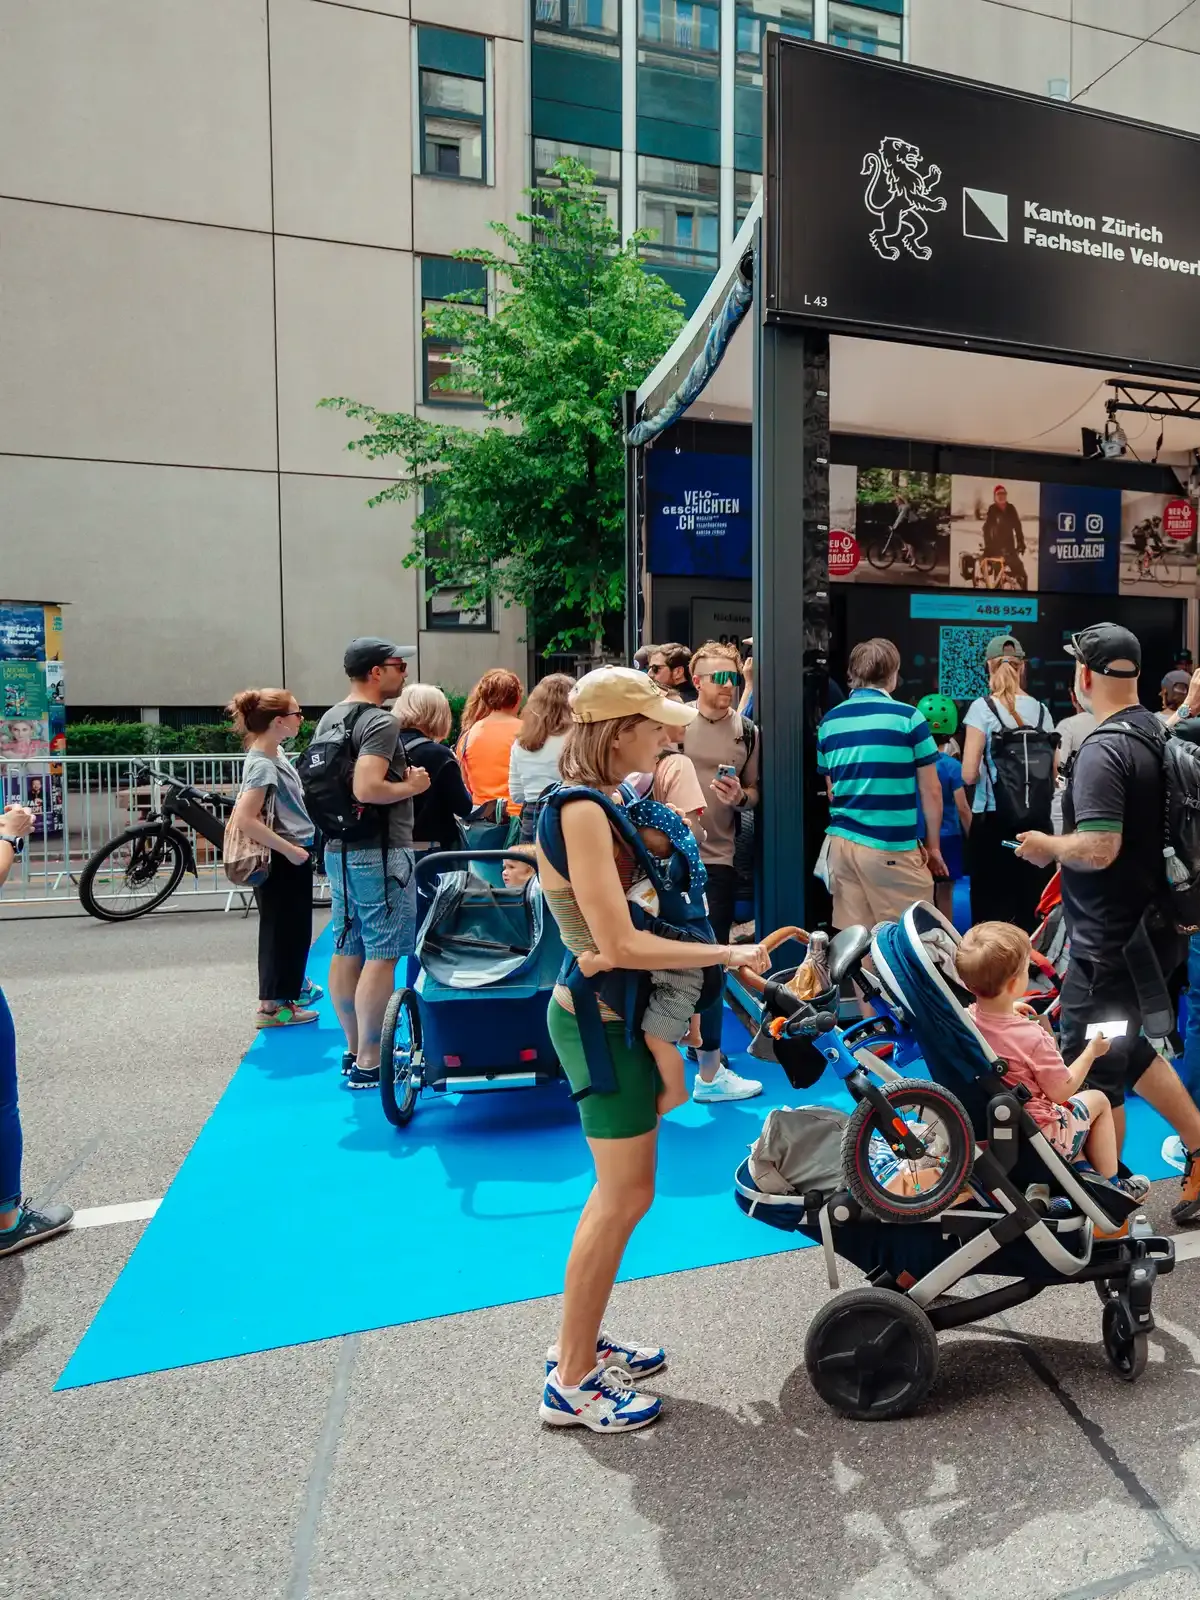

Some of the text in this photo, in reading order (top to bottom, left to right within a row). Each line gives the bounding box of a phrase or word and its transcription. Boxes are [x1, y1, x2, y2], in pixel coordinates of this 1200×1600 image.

[1024, 200, 1164, 244] Kanton Zürich
[1023, 226, 1125, 262] Fachstelle
[804, 294, 828, 307] L 43
[662, 498, 740, 515] GESCHICHTEN
[675, 514, 695, 530] .CH
[829, 539, 840, 548] EU
[828, 553, 855, 564] ODCAST
